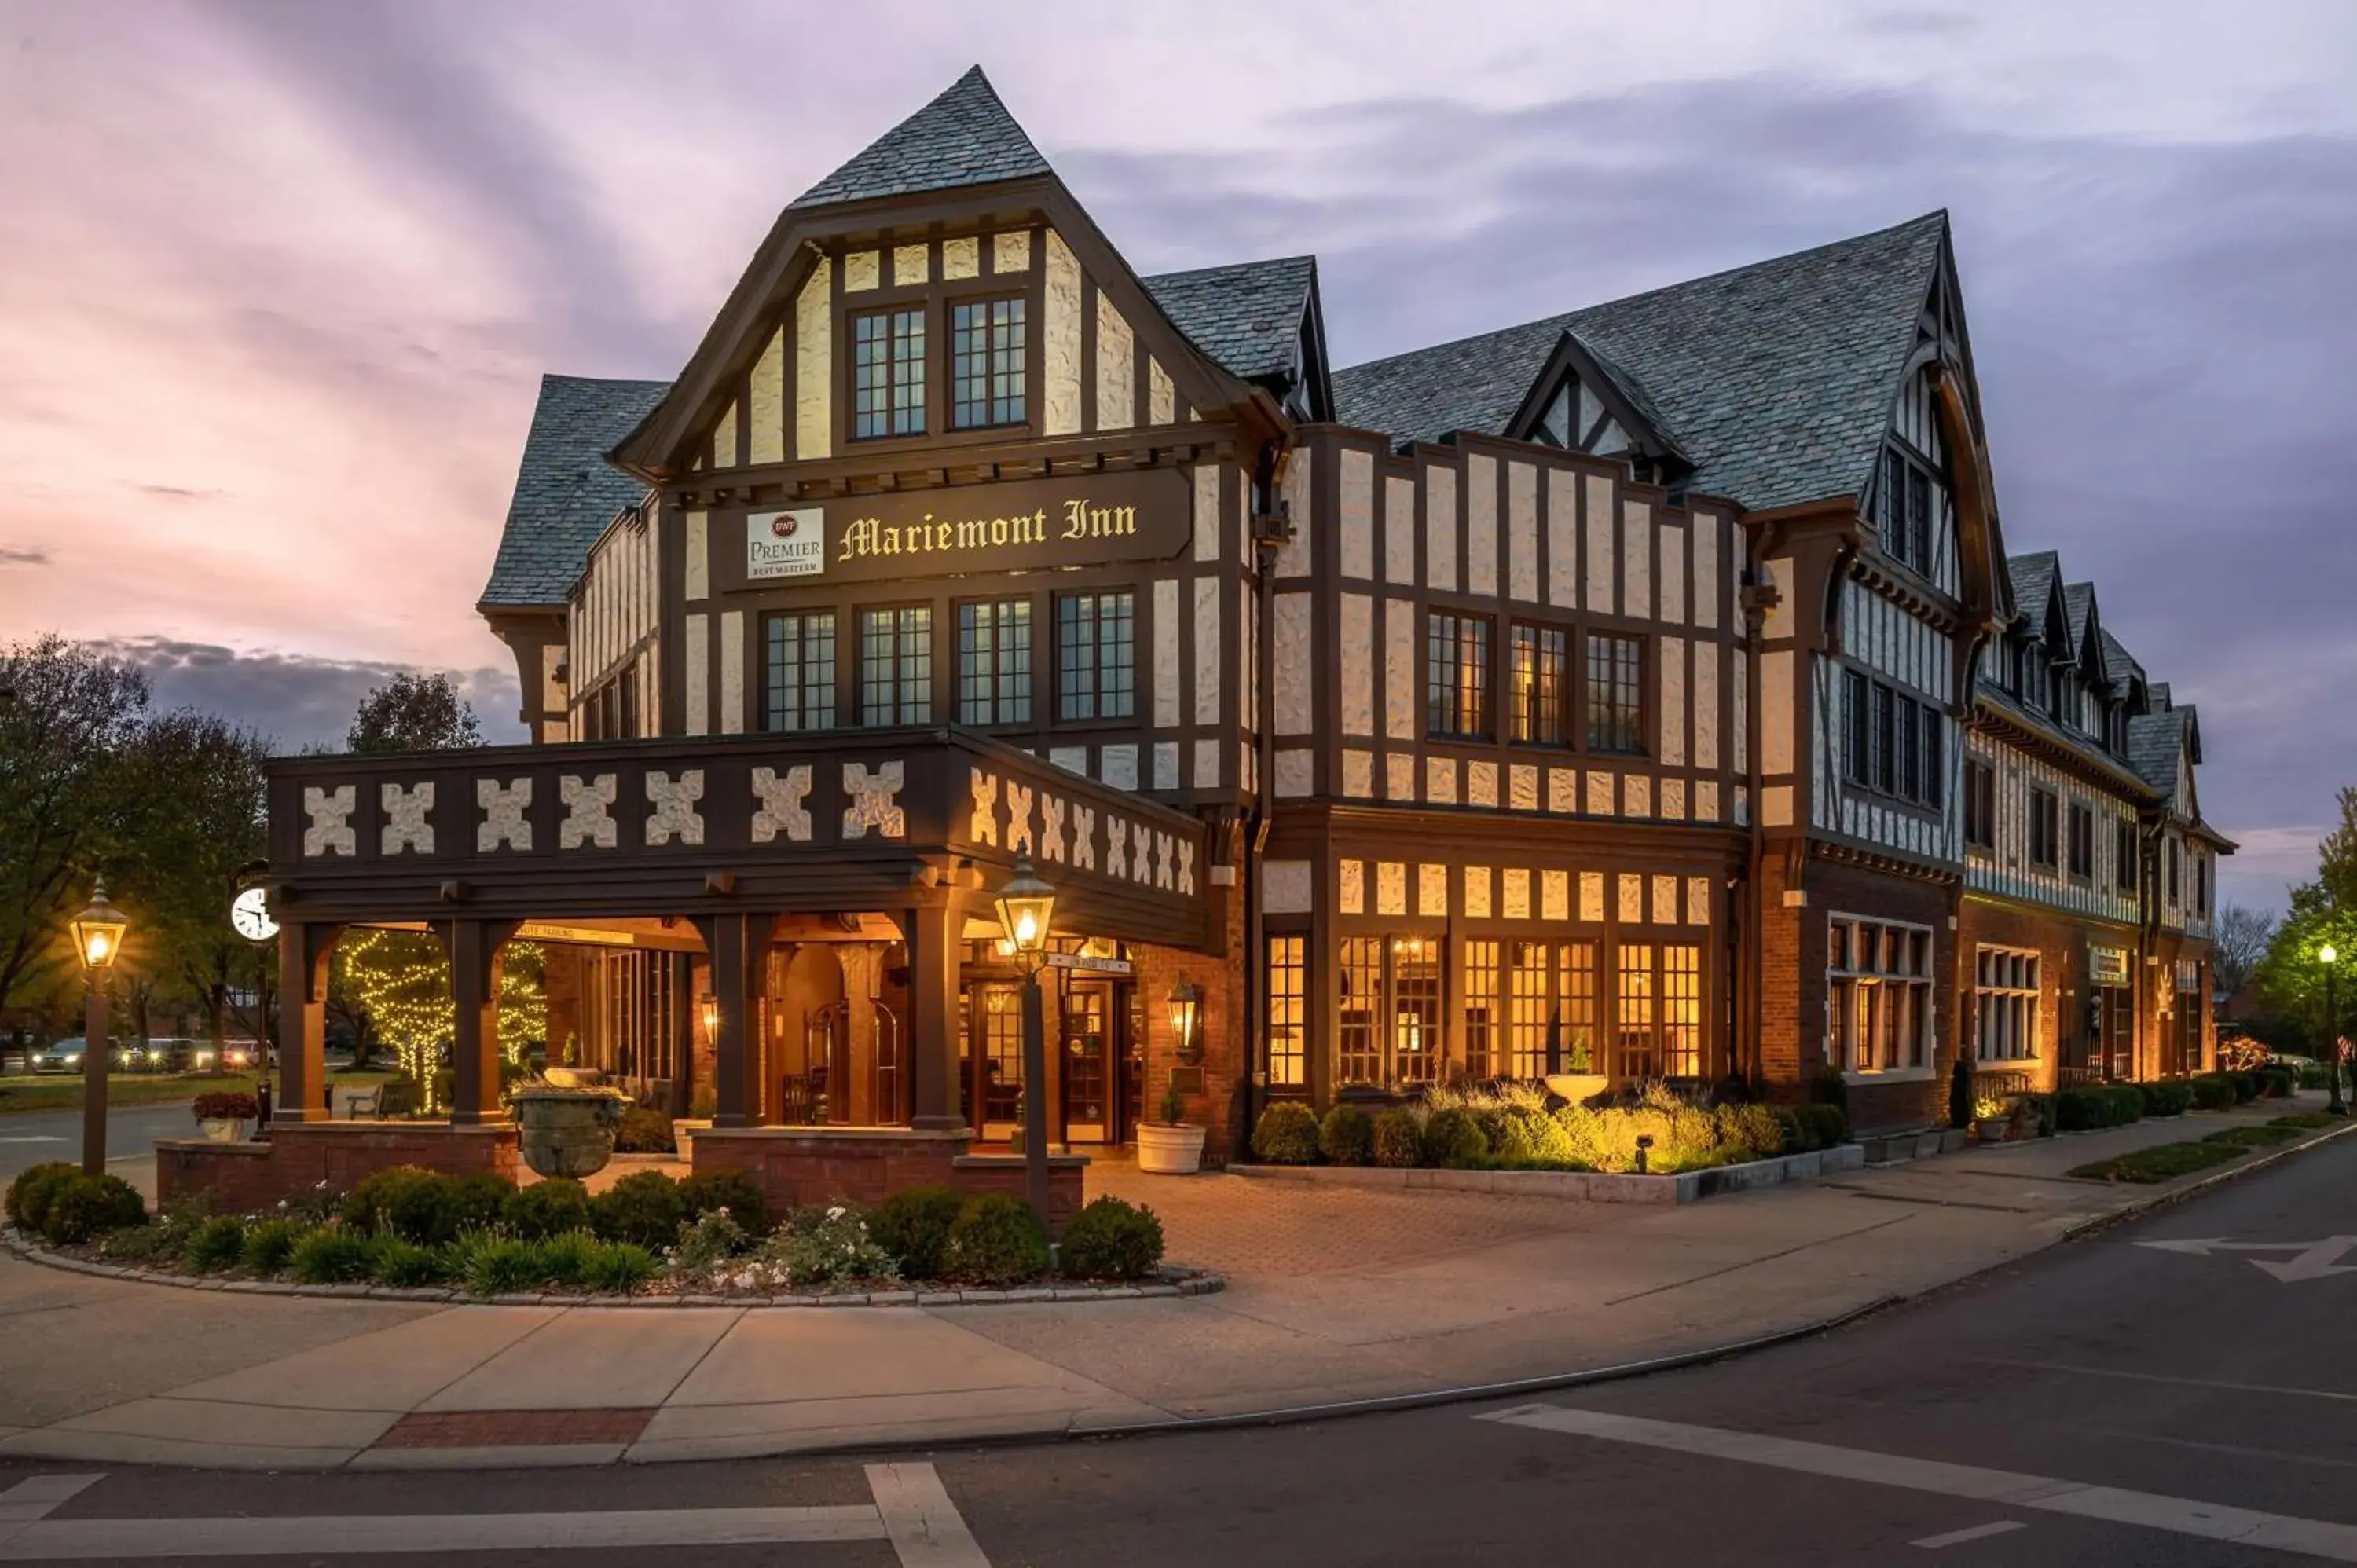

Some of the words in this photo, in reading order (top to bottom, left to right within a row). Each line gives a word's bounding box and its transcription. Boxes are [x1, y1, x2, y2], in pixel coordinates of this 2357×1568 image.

[838, 507, 1047, 562] Mariemont
[1061, 498, 1138, 540] Inn
[750, 540, 820, 562] PREMIER
[775, 563, 816, 574] WESTERN
